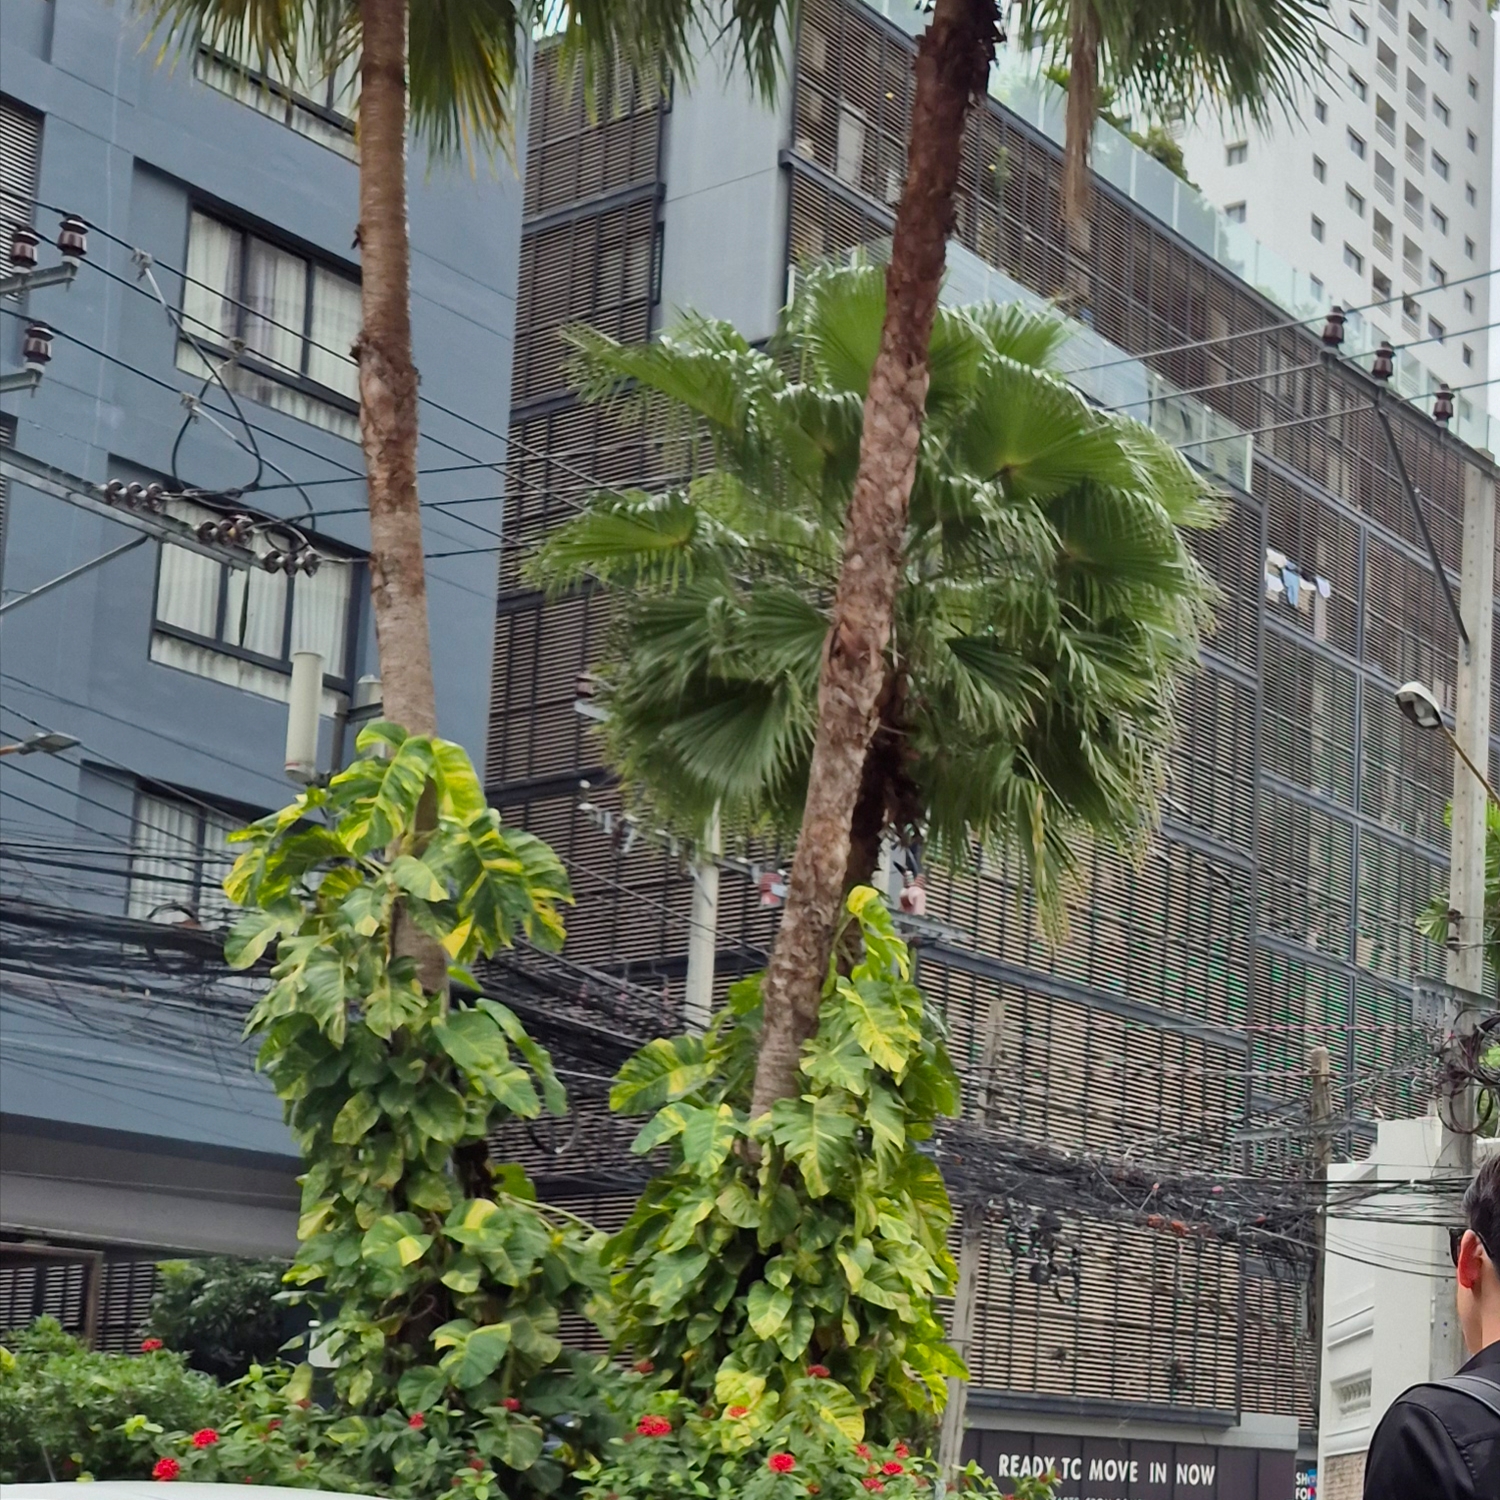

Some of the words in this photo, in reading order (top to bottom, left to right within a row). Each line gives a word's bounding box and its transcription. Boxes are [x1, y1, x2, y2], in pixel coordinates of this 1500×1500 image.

[999, 1454, 1055, 1478] READY
[1088, 1459, 1138, 1483] MOVE
[1149, 1462, 1167, 1484] IN
[1176, 1464, 1215, 1486] NOW
